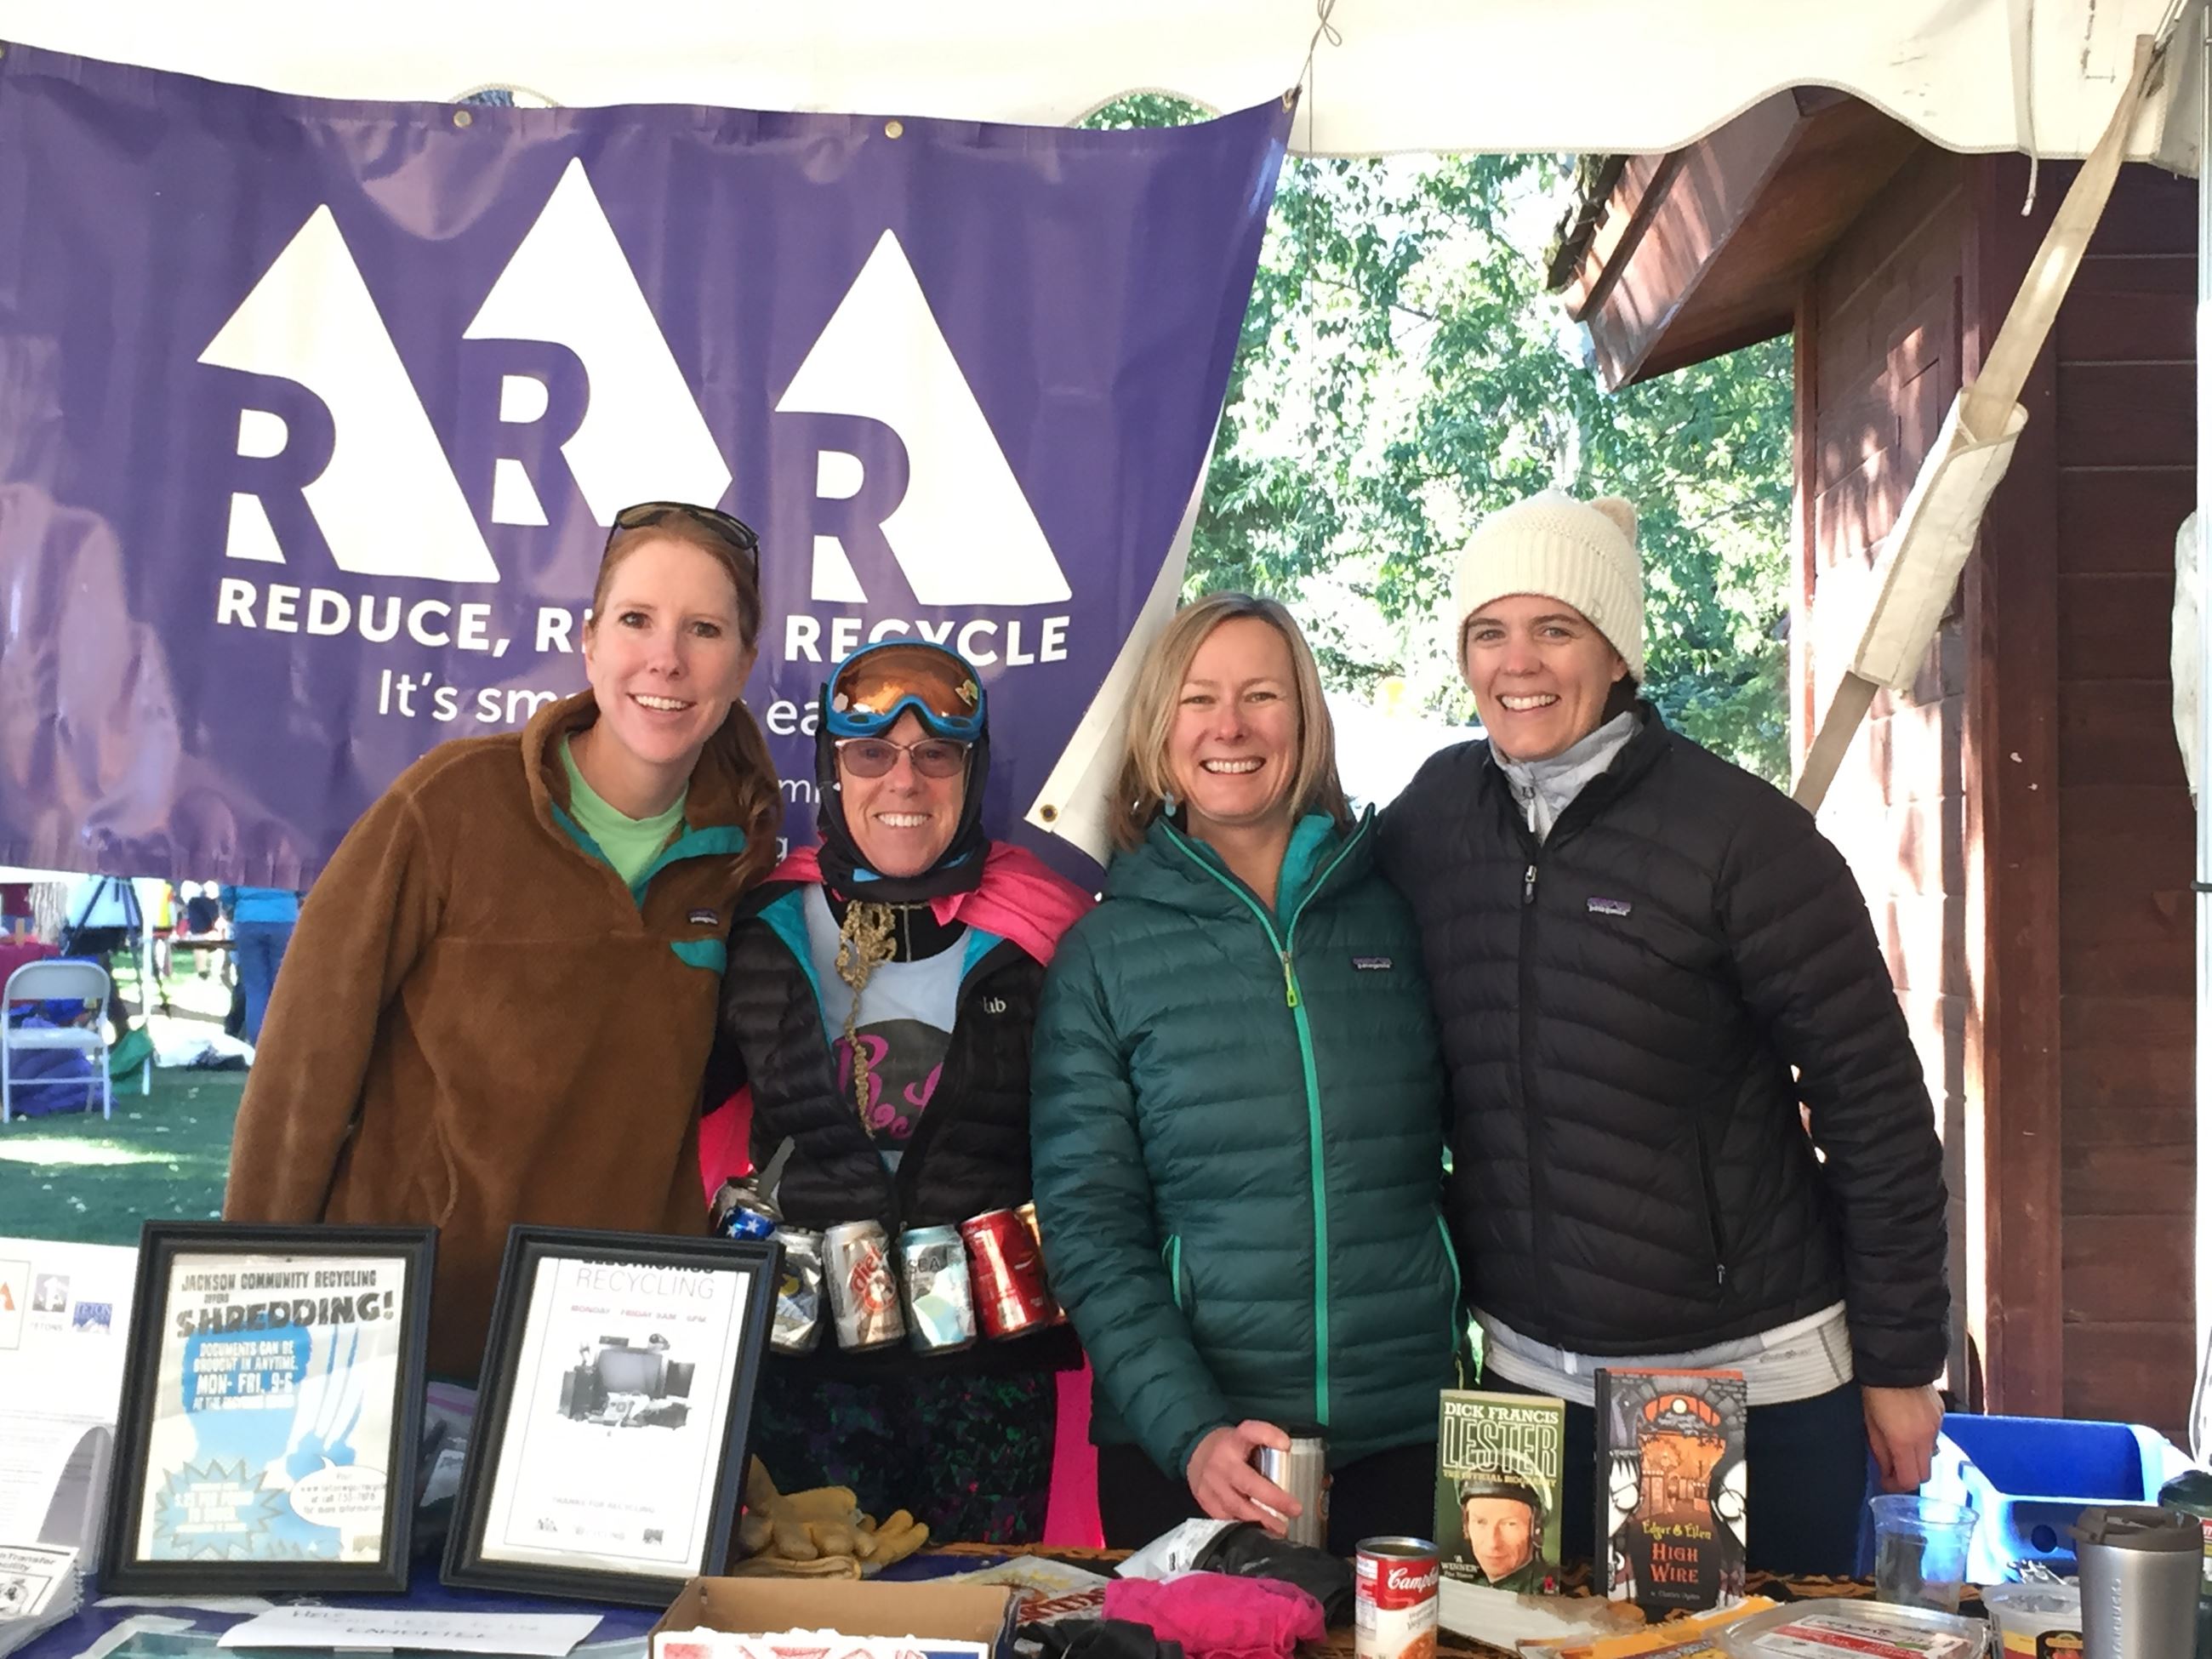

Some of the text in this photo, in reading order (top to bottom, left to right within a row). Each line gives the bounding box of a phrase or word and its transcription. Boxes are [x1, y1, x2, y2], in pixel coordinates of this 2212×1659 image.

[216, 577, 510, 658] REDUCE,
[379, 669, 459, 723] It's
[181, 1270, 377, 1291] JACKSON COMMUNITY RECYCLING
[576, 1267, 715, 1300] RECYCLING
[176, 1291, 394, 1338] SHREDDING!
[199, 1341, 294, 1357] DOCUMENTS CAN BE
[193, 1357, 238, 1373] BROUGHT
[241, 1356, 251, 1371] IN
[1444, 1401, 1559, 1425] DICK FRANCIS
[1442, 1416, 1559, 1478] LESTER
[1442, 1469, 1460, 1479] THE
[1642, 1519, 1712, 1541] Edgar & Ellen
[1651, 1542, 1699, 1563] HIGH
[1650, 1563, 1699, 1583] WIRE
